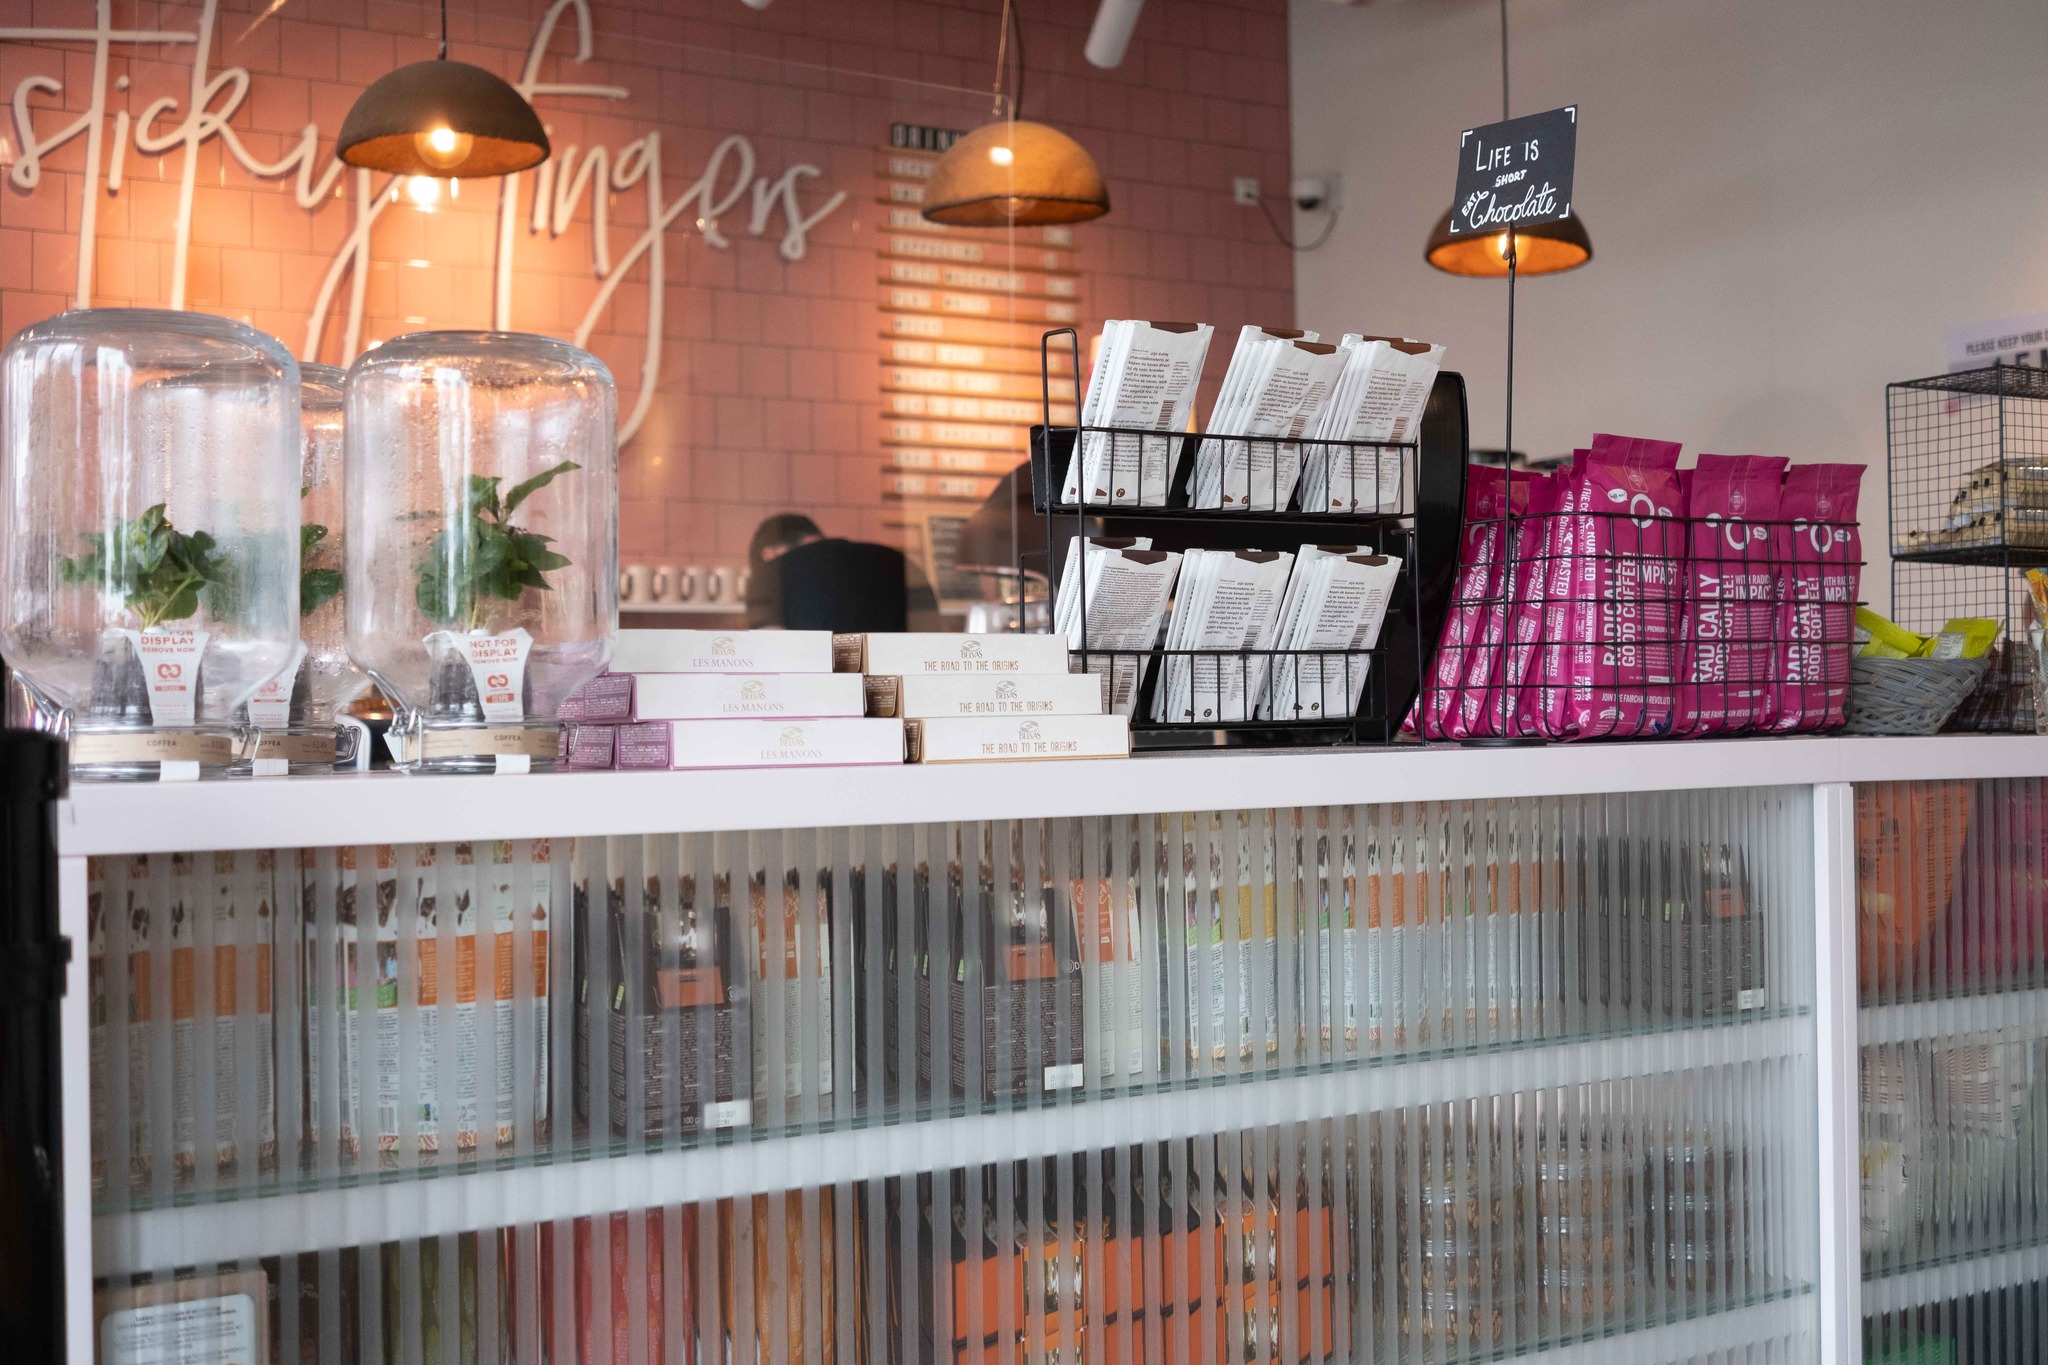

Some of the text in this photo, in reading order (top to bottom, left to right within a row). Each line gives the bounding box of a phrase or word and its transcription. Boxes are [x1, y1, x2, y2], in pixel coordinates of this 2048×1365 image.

[1476, 139, 1539, 171] LIFE IS
[1494, 169, 1528, 188] SHORT
[1461, 192, 1477, 216] EAT
[1470, 182, 1556, 229] Chocolate
[1966, 338, 1995, 355] PLEASE
[1998, 334, 2019, 349] KEEP
[2021, 331, 2042, 345] YOUR
[1581, 488, 1591, 502] THE
[1637, 565, 1677, 586] IMPACT
[1603, 549, 1622, 666] RADICALLY
[1622, 552, 1635, 667] GOOD COFFEE!
[141, 637, 194, 645] DISPLAY
[469, 638, 517, 648] NOT FOR
[471, 648, 517, 657] DISPLAY
[693, 659, 754, 668] LES MANONS
[924, 660, 1019, 671] THE ROAD TO THE ORIGINS
[1807, 644, 1822, 685] GOOD
[1602, 693, 1614, 702] JOIN
[722, 702, 784, 712] LES MANONS
[960, 700, 1053, 713] THE ROAD TO THE ORIGINS
[982, 741, 1077, 754] THE ROAD TO THE ORIGINS
[761, 749, 823, 760] LES MANONS
